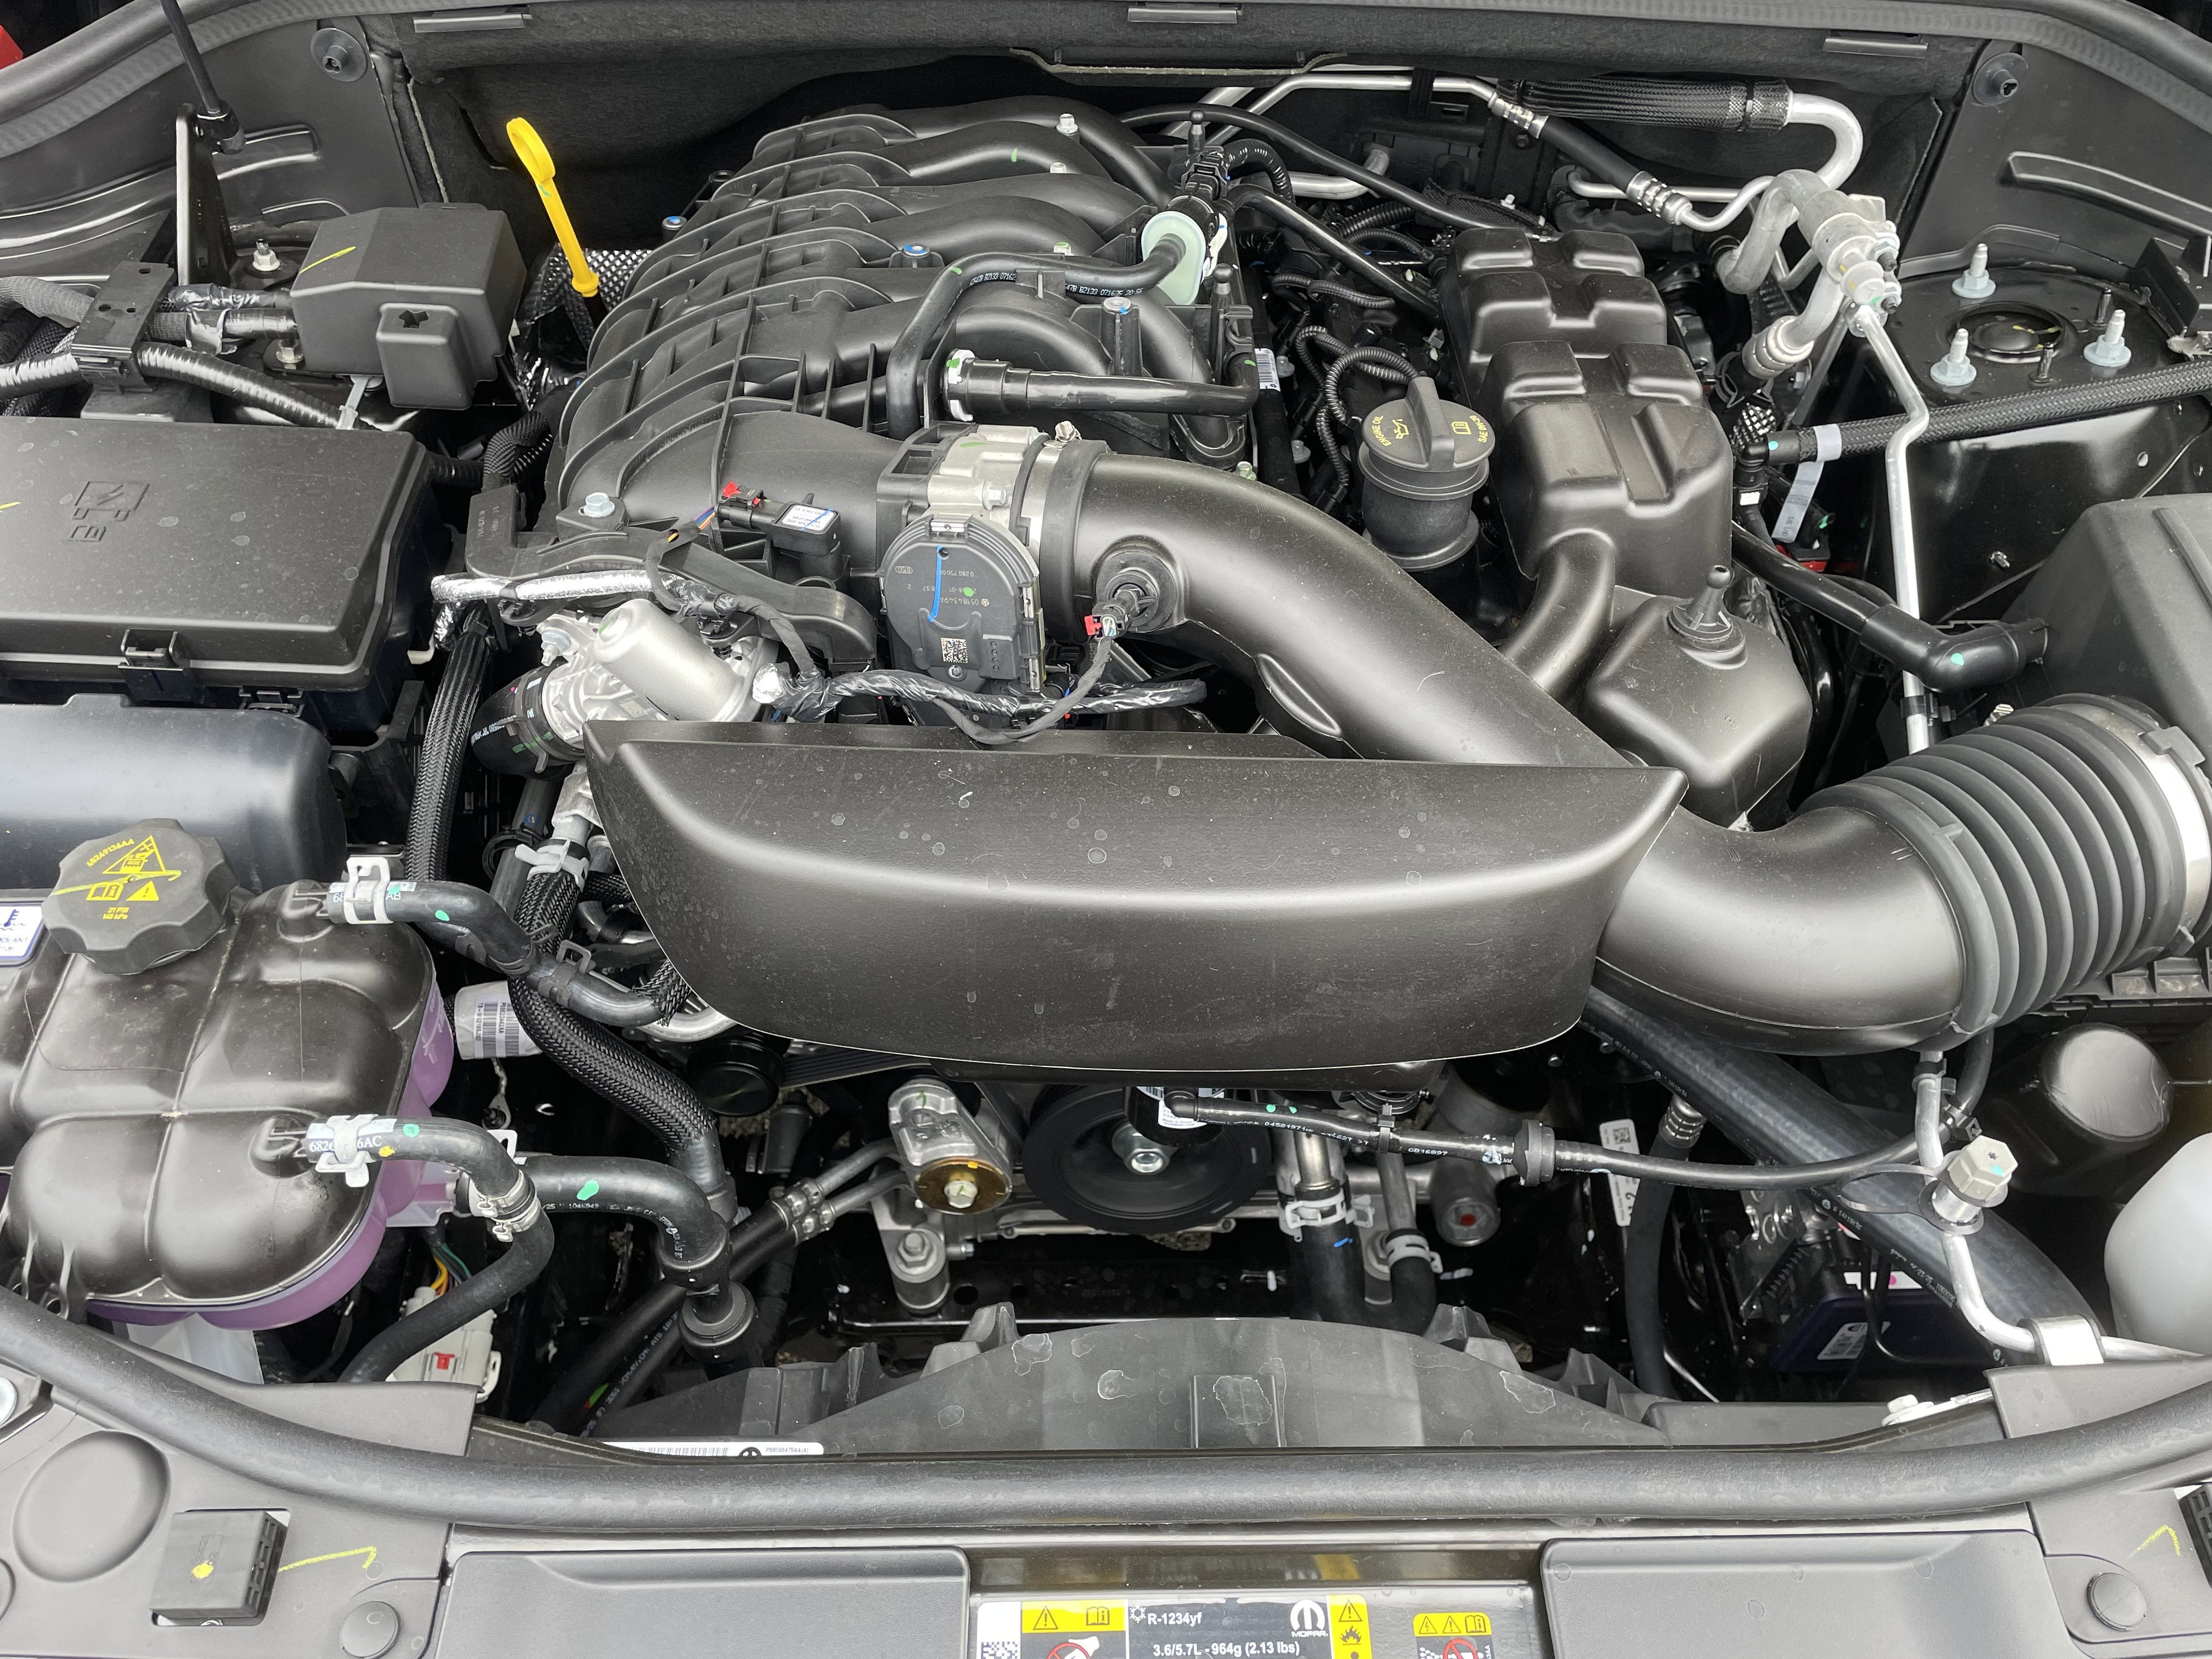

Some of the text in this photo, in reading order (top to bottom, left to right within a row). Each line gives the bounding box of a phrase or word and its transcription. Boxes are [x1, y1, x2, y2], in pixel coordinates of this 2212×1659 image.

[1372, 415, 1392, 447] ENGINE OIL
[1478, 430, 1488, 443] SAE
[86, 838, 135, 867] 68249136AA
[1147, 1612, 1203, 1627] R-1234yf
[1153, 1643, 1202, 1656] 3.6/5.7L
[1211, 1641, 1242, 1657] 964g
[1245, 1641, 1276, 1657] (2.13
[1277, 1640, 1300, 1656] lbs)
